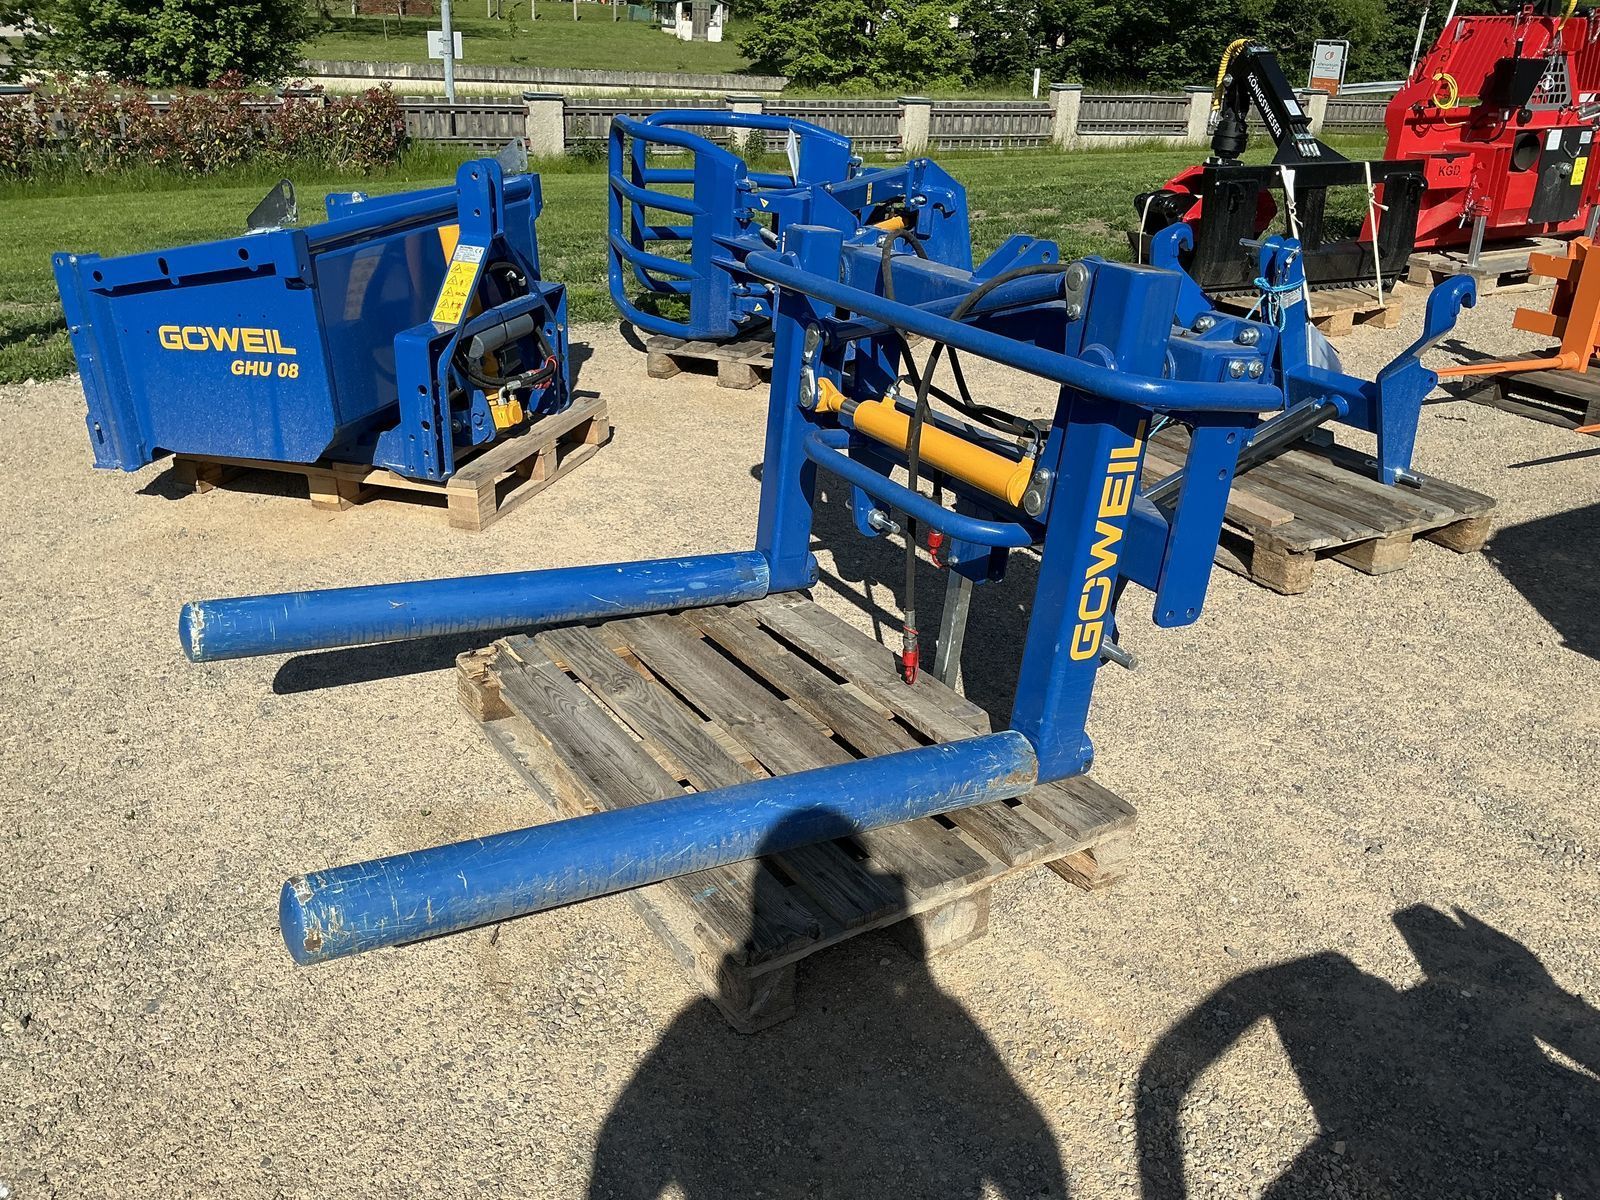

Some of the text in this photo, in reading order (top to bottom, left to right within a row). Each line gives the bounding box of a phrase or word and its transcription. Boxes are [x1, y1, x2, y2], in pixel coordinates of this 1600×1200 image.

[1247, 72, 1282, 138] KÖNIGSWIESER
[1438, 164, 1461, 177] KGD
[231, 359, 299, 378] GHU 08
